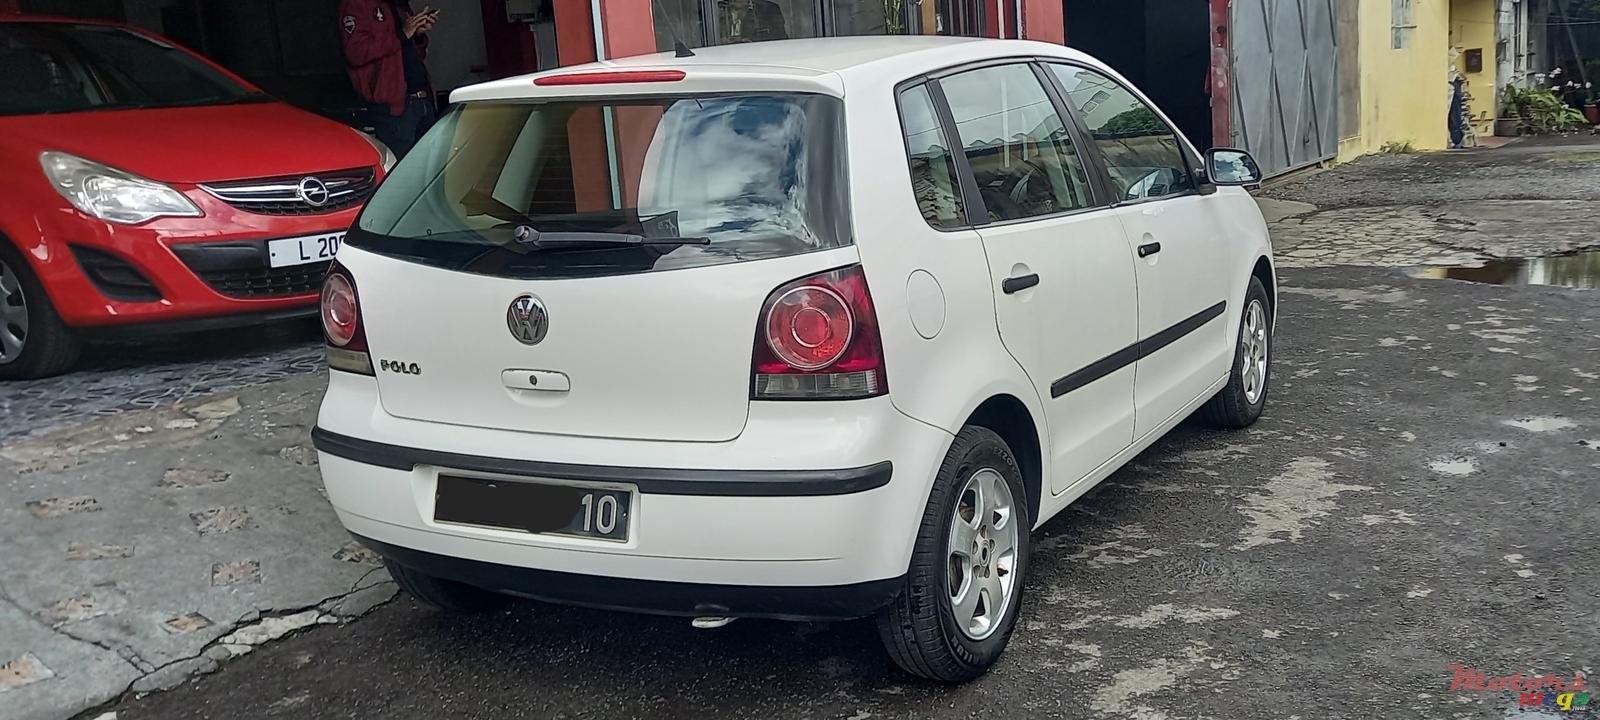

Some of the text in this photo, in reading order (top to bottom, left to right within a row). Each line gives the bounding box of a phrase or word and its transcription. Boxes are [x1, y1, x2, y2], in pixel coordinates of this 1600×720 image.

[299, 235, 345, 261] L 20
[380, 359, 422, 375] POLO
[581, 493, 618, 535] 10
